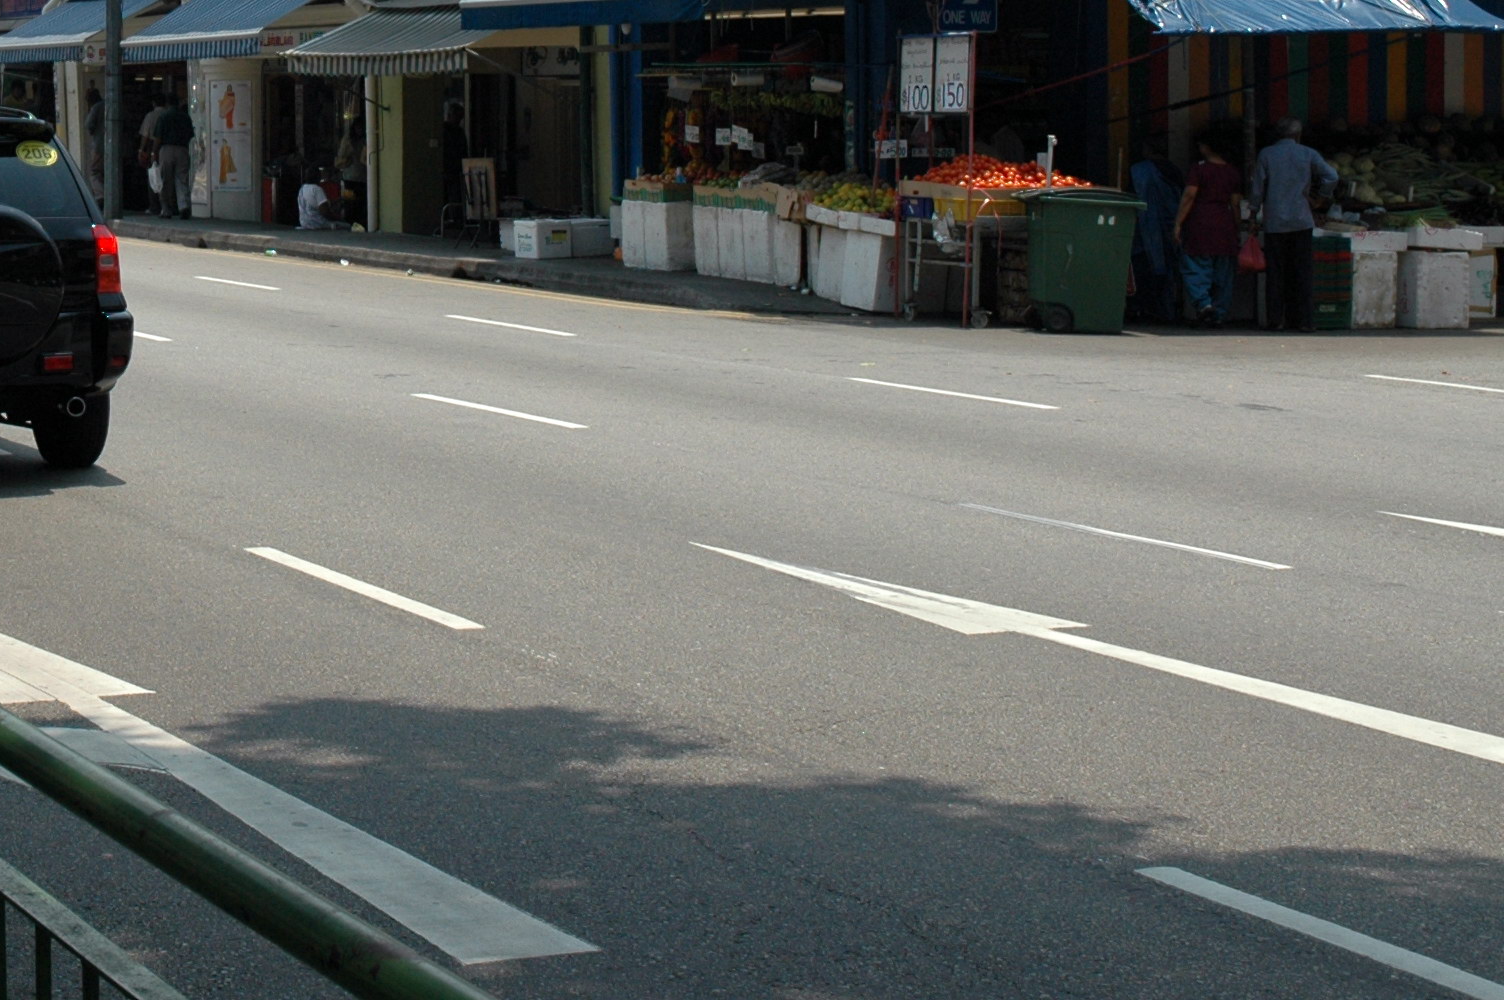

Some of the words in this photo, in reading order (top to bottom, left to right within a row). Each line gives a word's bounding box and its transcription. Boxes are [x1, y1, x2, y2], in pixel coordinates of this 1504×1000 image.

[943, 10, 966, 25] ONE
[970, 10, 992, 25] WAY
[21, 147, 52, 160] 206
